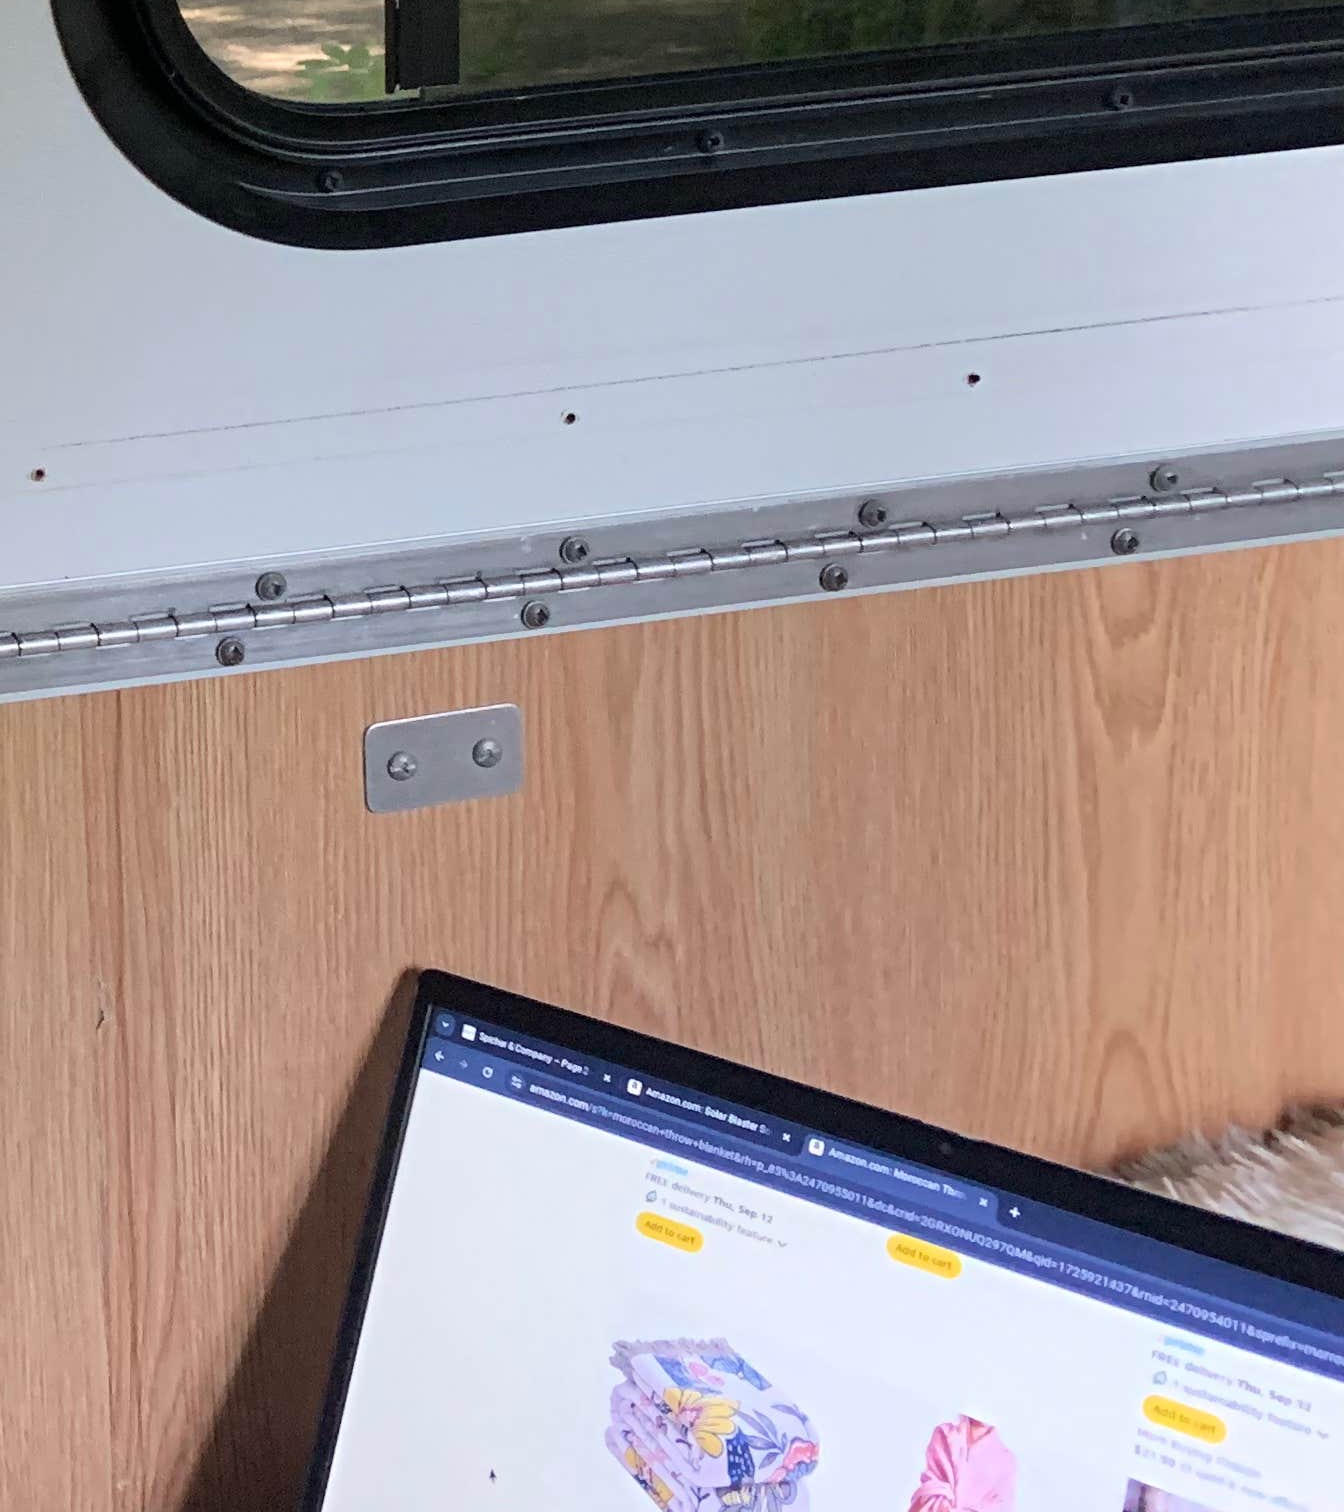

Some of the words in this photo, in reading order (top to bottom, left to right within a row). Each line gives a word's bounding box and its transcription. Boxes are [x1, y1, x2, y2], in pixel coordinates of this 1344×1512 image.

[515, 1043, 553, 1064] Company
[561, 1058, 583, 1074] Page
[645, 1087, 704, 1113] Amazon.com:
[704, 1105, 728, 1121] Solar
[727, 1113, 759, 1132] Blaster
[828, 1147, 894, 1176] Amazon.com:
[671, 1181, 712, 1203] delivery
[738, 1204, 757, 1220] Sep
[761, 1212, 774, 1225] 12
[645, 1220, 664, 1234] Add
[676, 1232, 696, 1246] cart
[896, 1243, 916, 1258] Add
[918, 1251, 930, 1263] to
[932, 1257, 952, 1271] cart
[1153, 1404, 1176, 1422] Add
